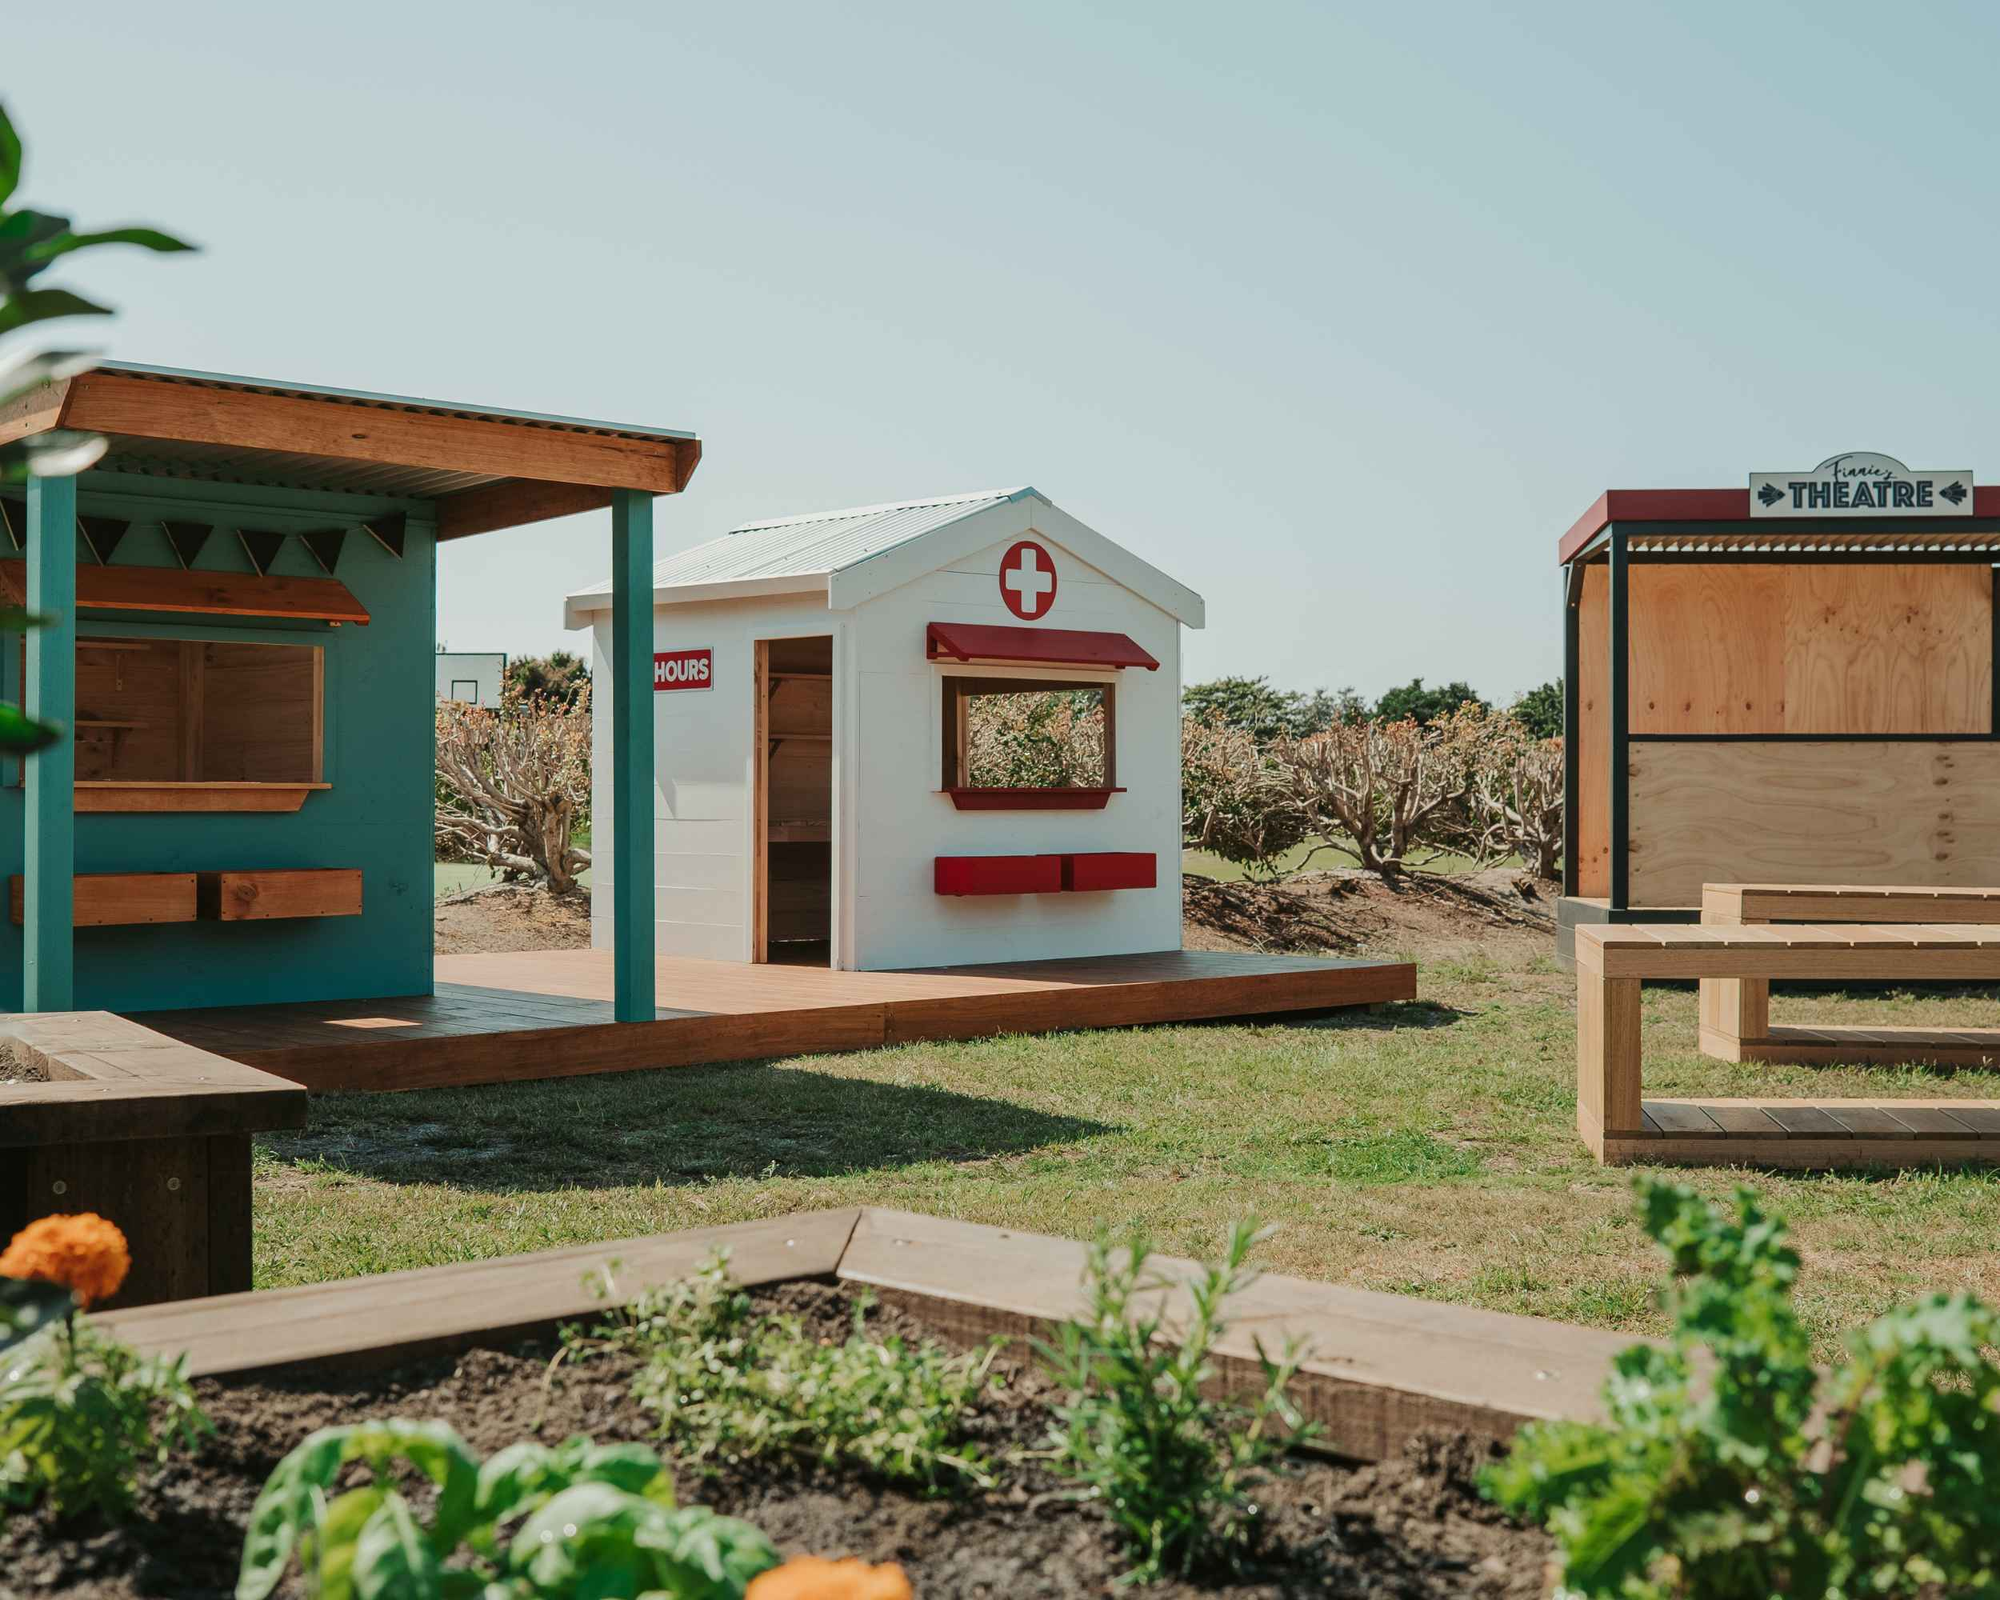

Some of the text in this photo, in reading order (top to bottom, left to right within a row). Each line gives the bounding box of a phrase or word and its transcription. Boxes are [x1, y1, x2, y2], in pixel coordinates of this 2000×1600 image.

[1824, 455, 1897, 482] Finnie's
[1788, 481, 1933, 508] THEATRE
[654, 658, 709, 683] HOURS
